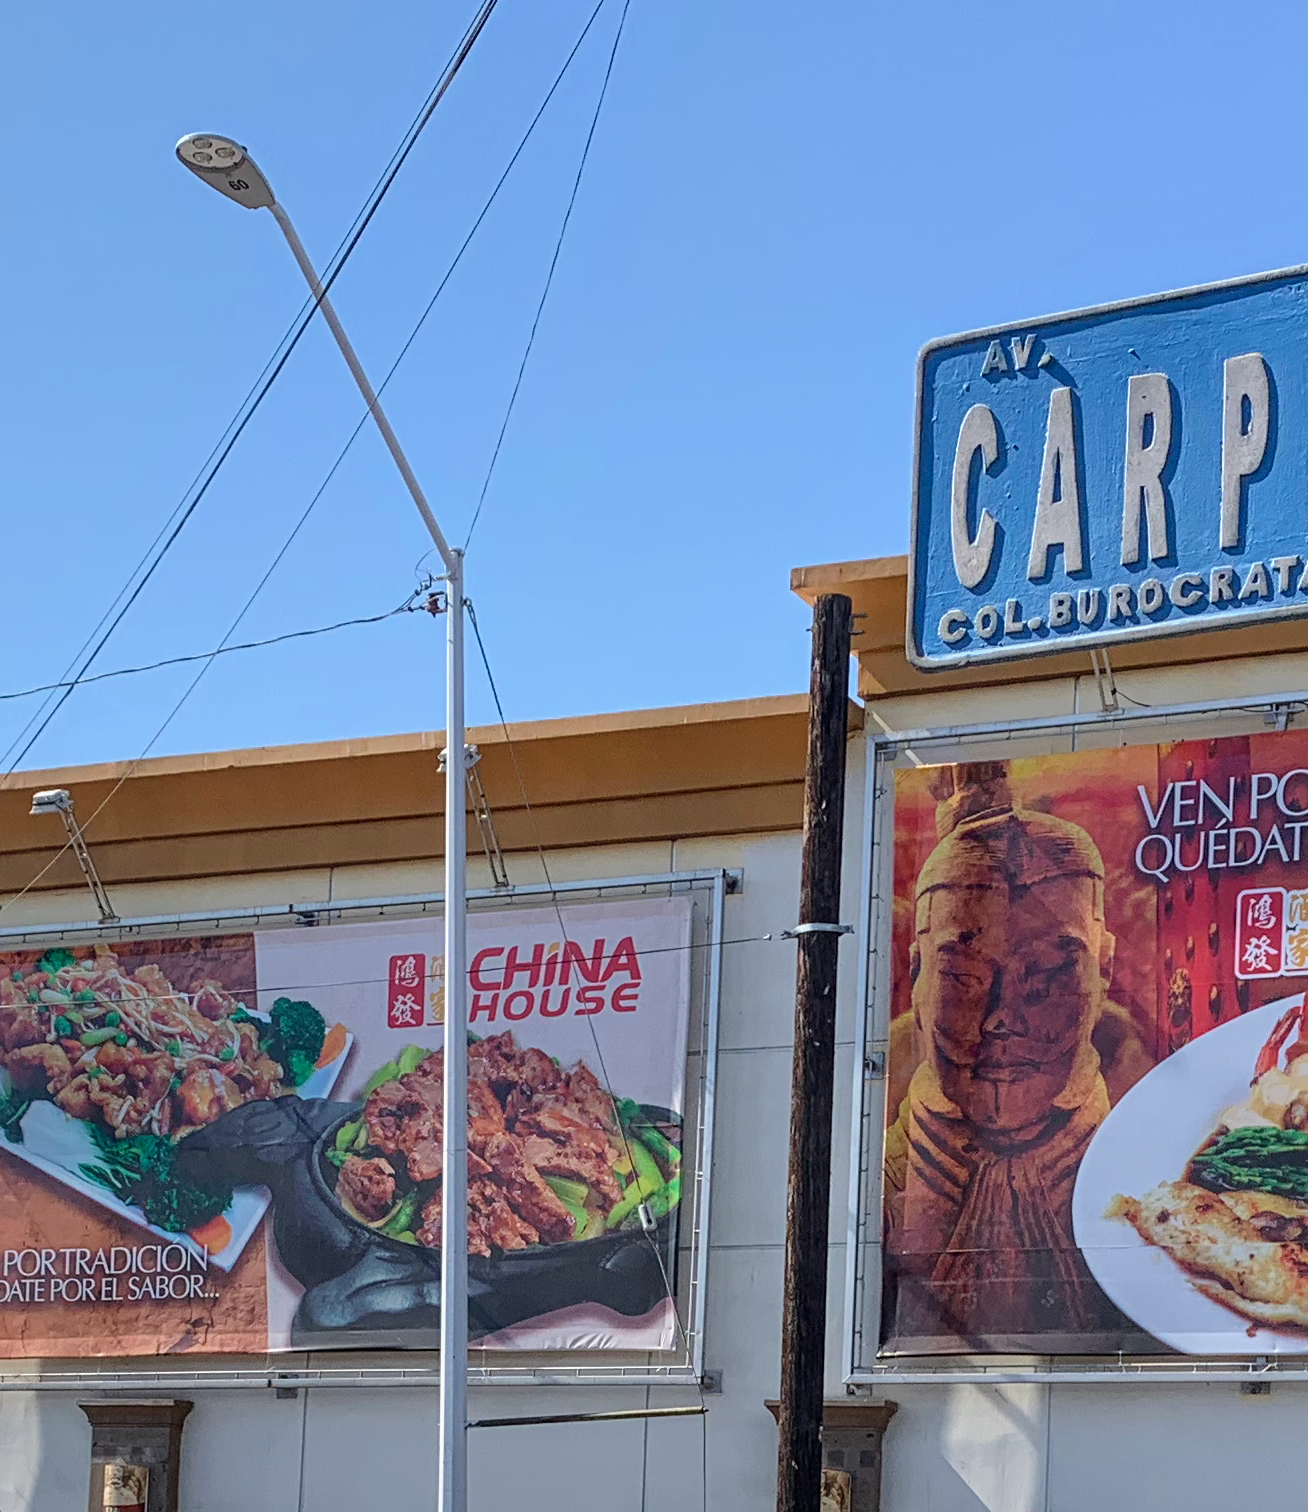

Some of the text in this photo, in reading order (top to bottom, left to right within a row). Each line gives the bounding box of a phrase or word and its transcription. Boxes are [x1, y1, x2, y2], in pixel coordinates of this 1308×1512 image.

[980, 334, 1055, 380] AV.
[1137, 776, 1235, 829] VEN
[469, 936, 642, 992] CHINA
[469, 982, 642, 1023] HOUSE
[3, 1248, 56, 1277] POR
[60, 1237, 208, 1275] TRADICIÓN
[50, 1277, 100, 1302] POR
[101, 1277, 123, 1301] EL
[128, 1274, 220, 1301] SABOR...
